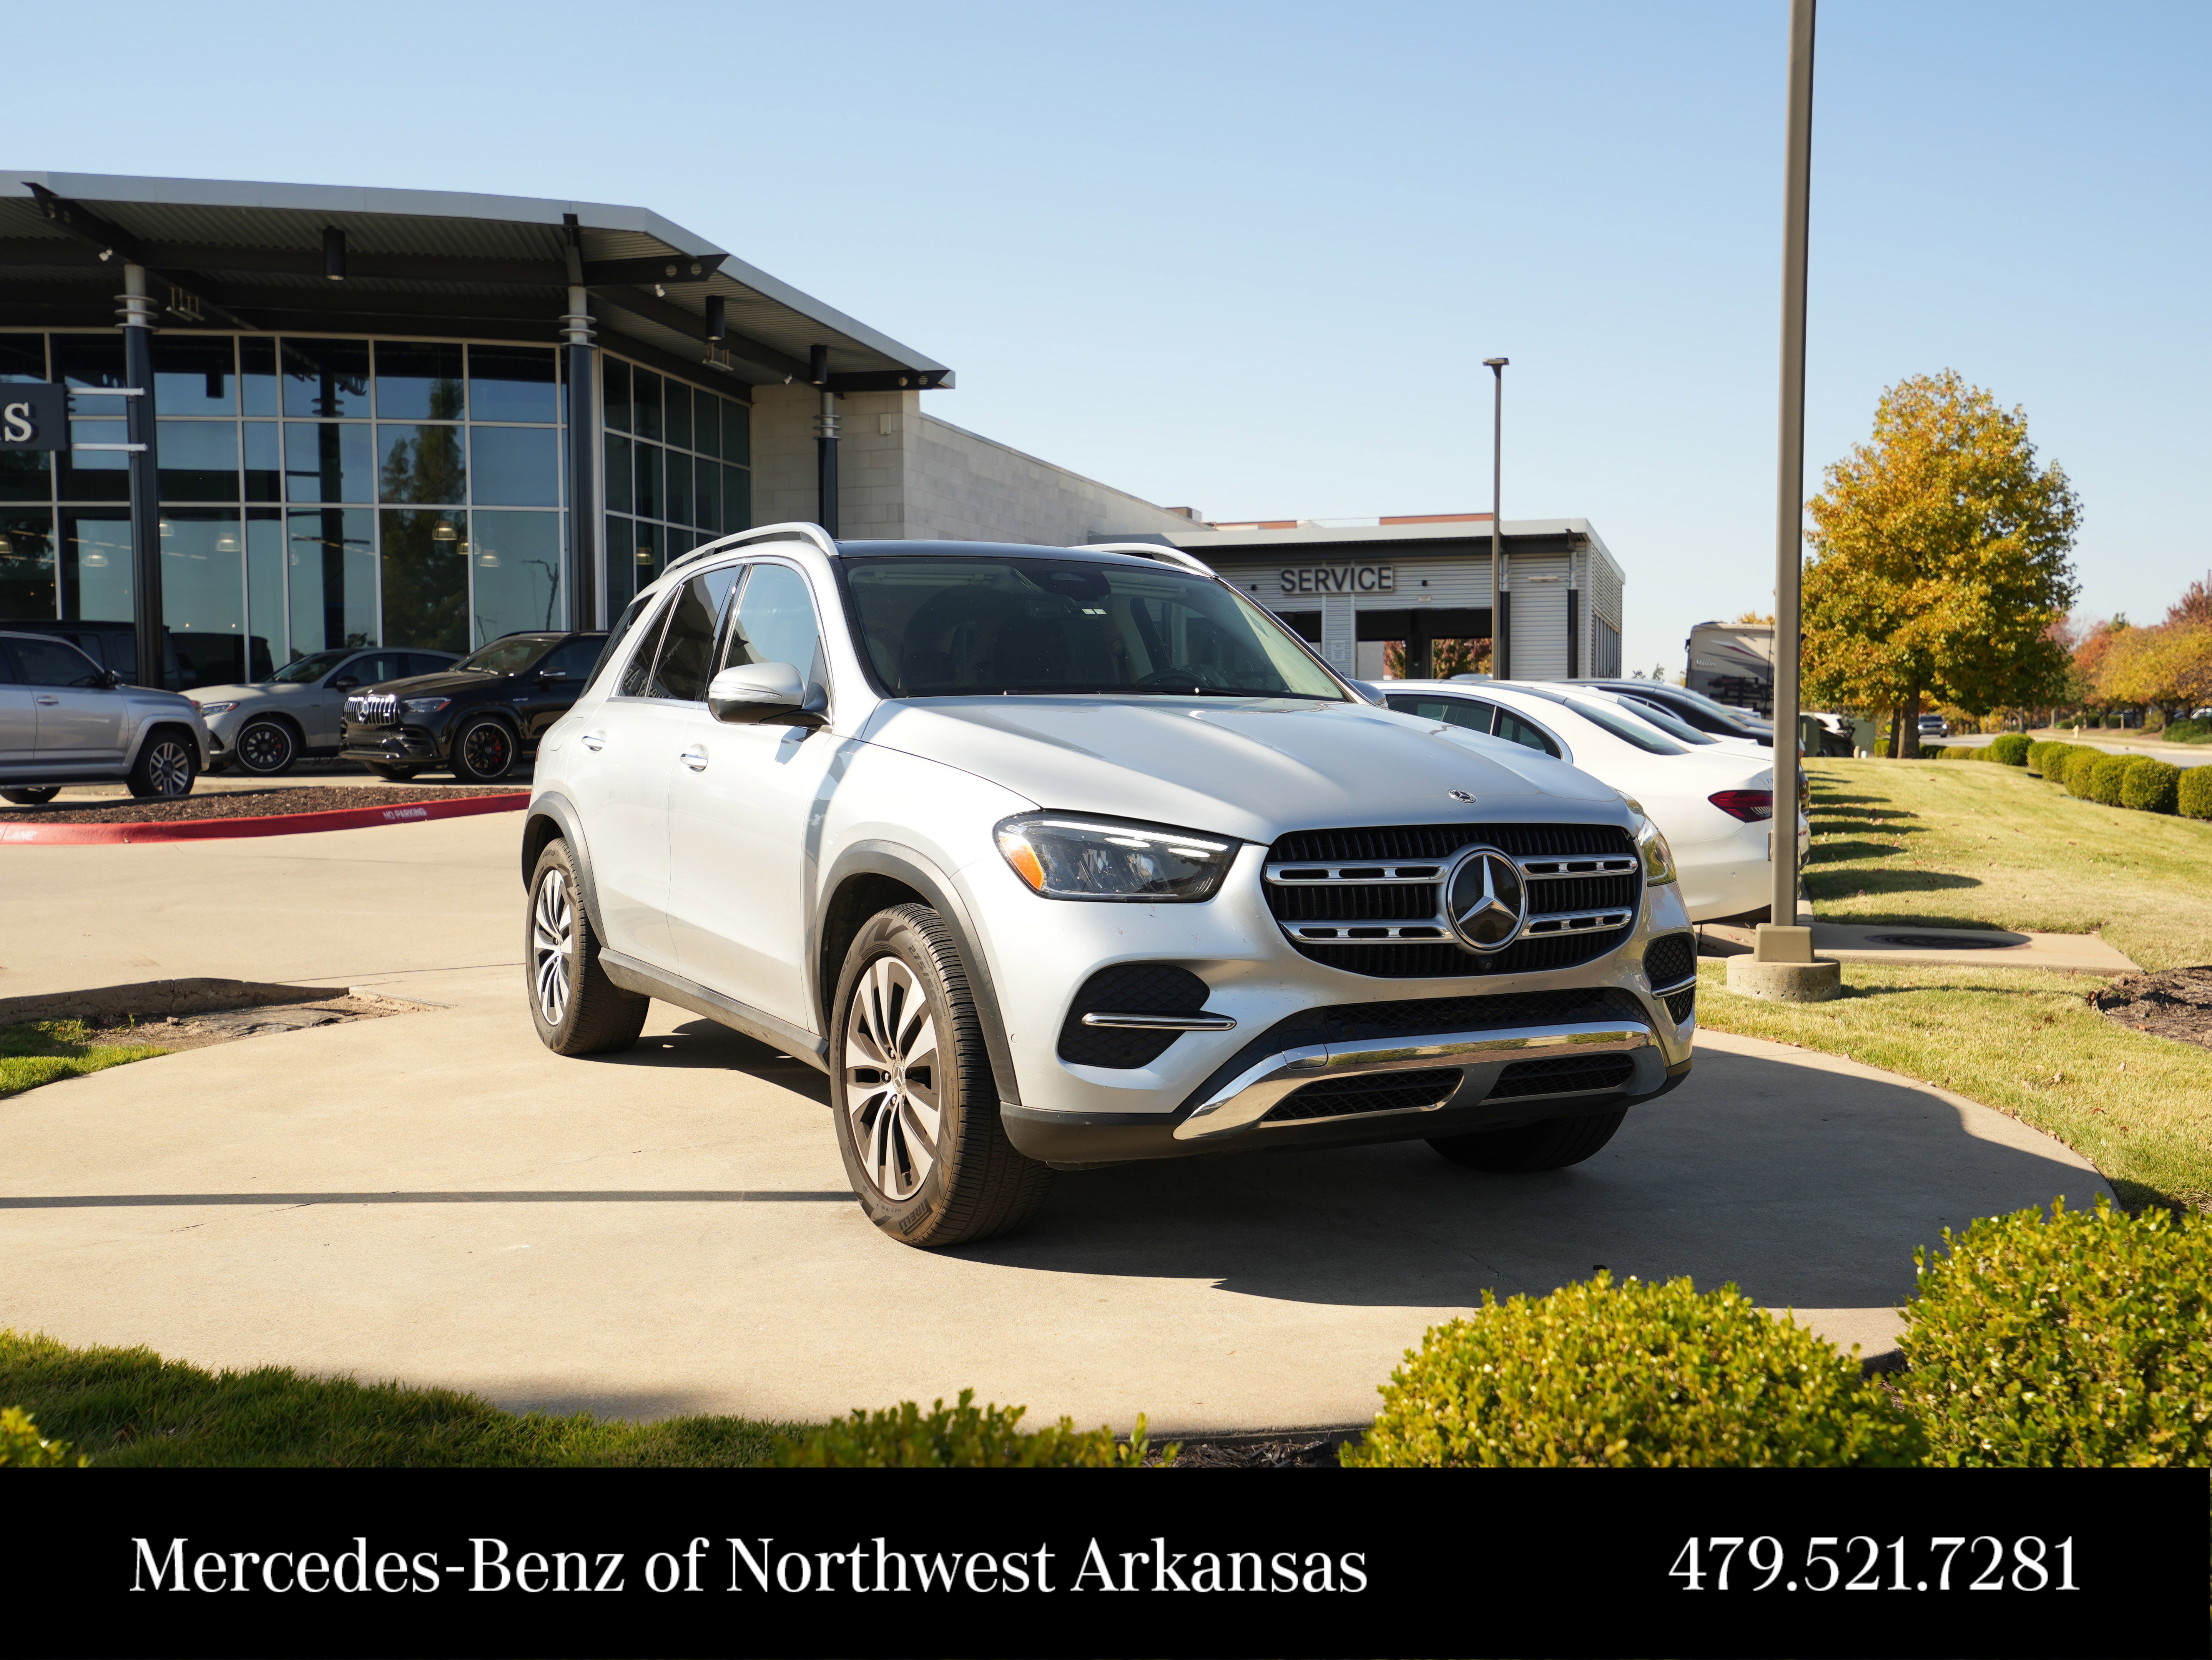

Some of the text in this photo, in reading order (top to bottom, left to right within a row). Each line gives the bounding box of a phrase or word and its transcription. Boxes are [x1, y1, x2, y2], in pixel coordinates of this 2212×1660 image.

[1280, 567, 1392, 592] SERVICE
[382, 807, 427, 820] NO PARKING
[3, 830, 38, 841] LANE
[908, 945, 937, 1002] 275/50
[899, 1197, 934, 1236] PIRELLI
